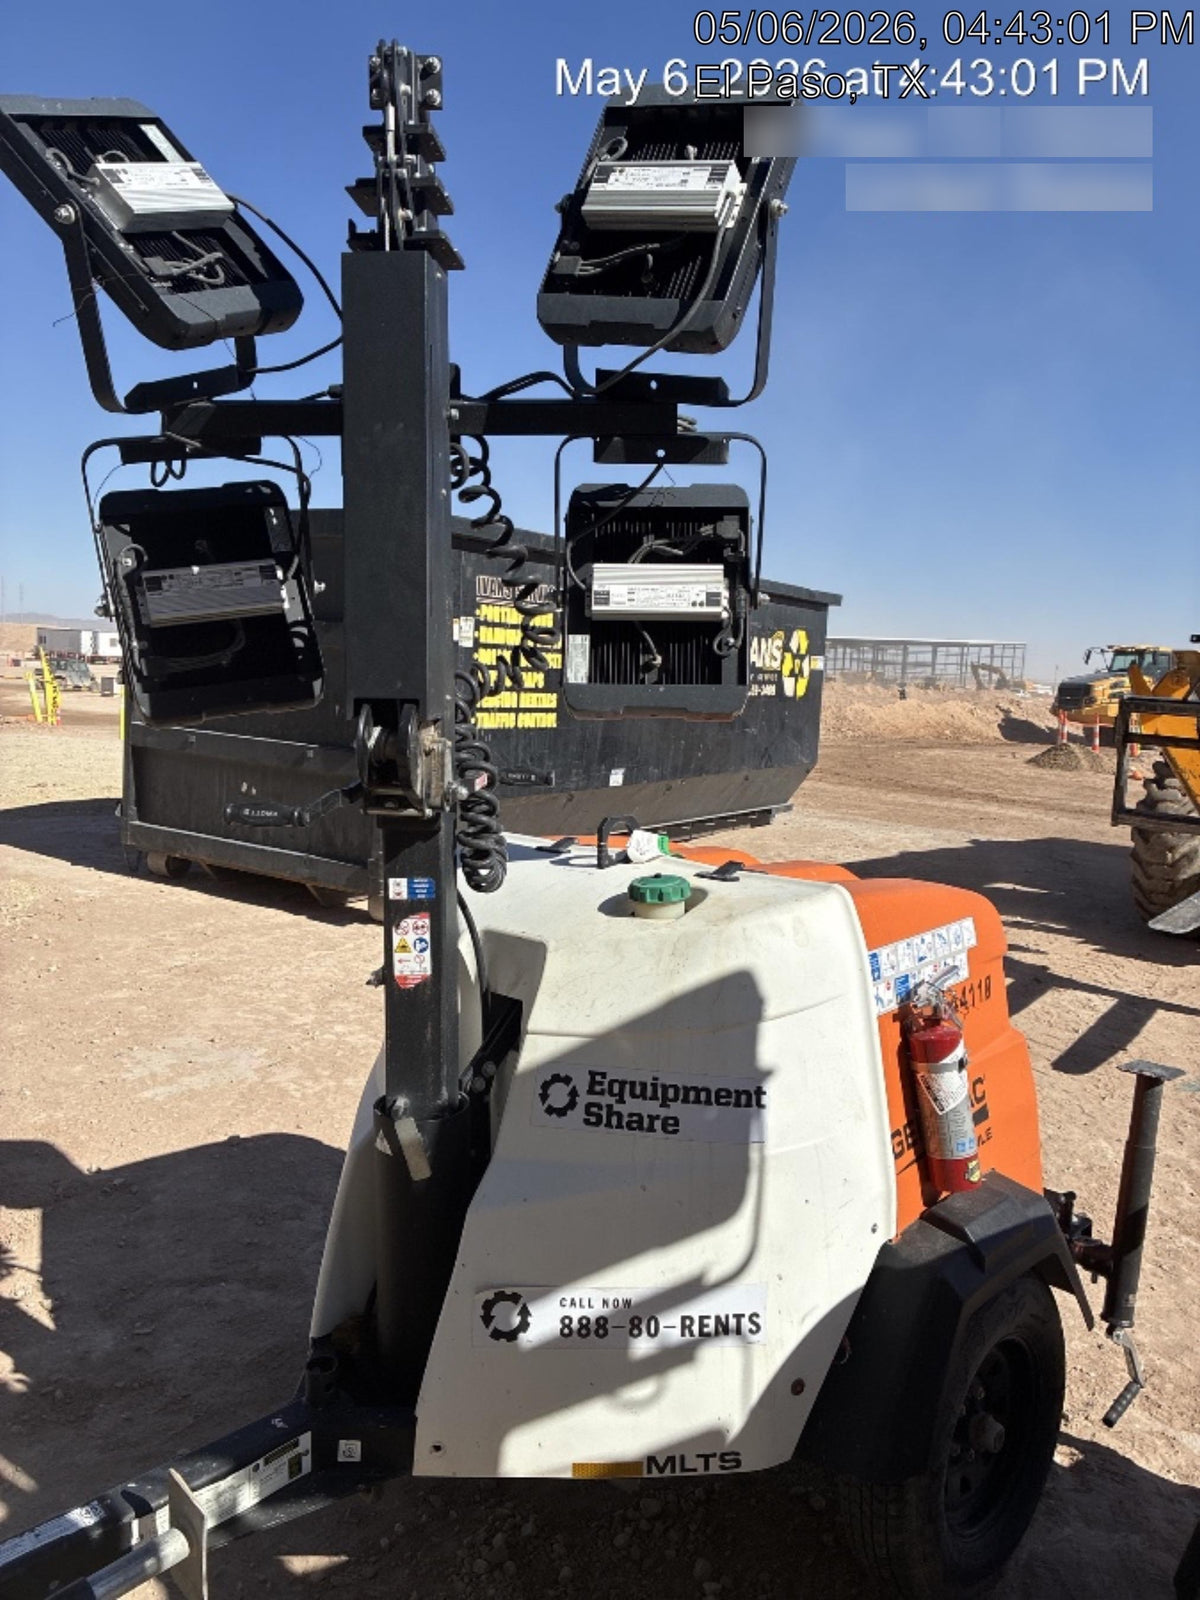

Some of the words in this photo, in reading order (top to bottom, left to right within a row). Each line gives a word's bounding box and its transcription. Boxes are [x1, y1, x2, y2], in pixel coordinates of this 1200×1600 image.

[586, 1070, 767, 1110] Equipment
[583, 1103, 681, 1135] Share
[559, 1297, 595, 1309] CALL
[601, 1297, 633, 1310] NOW
[559, 1312, 762, 1338] 888-80-RENTS
[646, 1451, 742, 1475] MLTS
